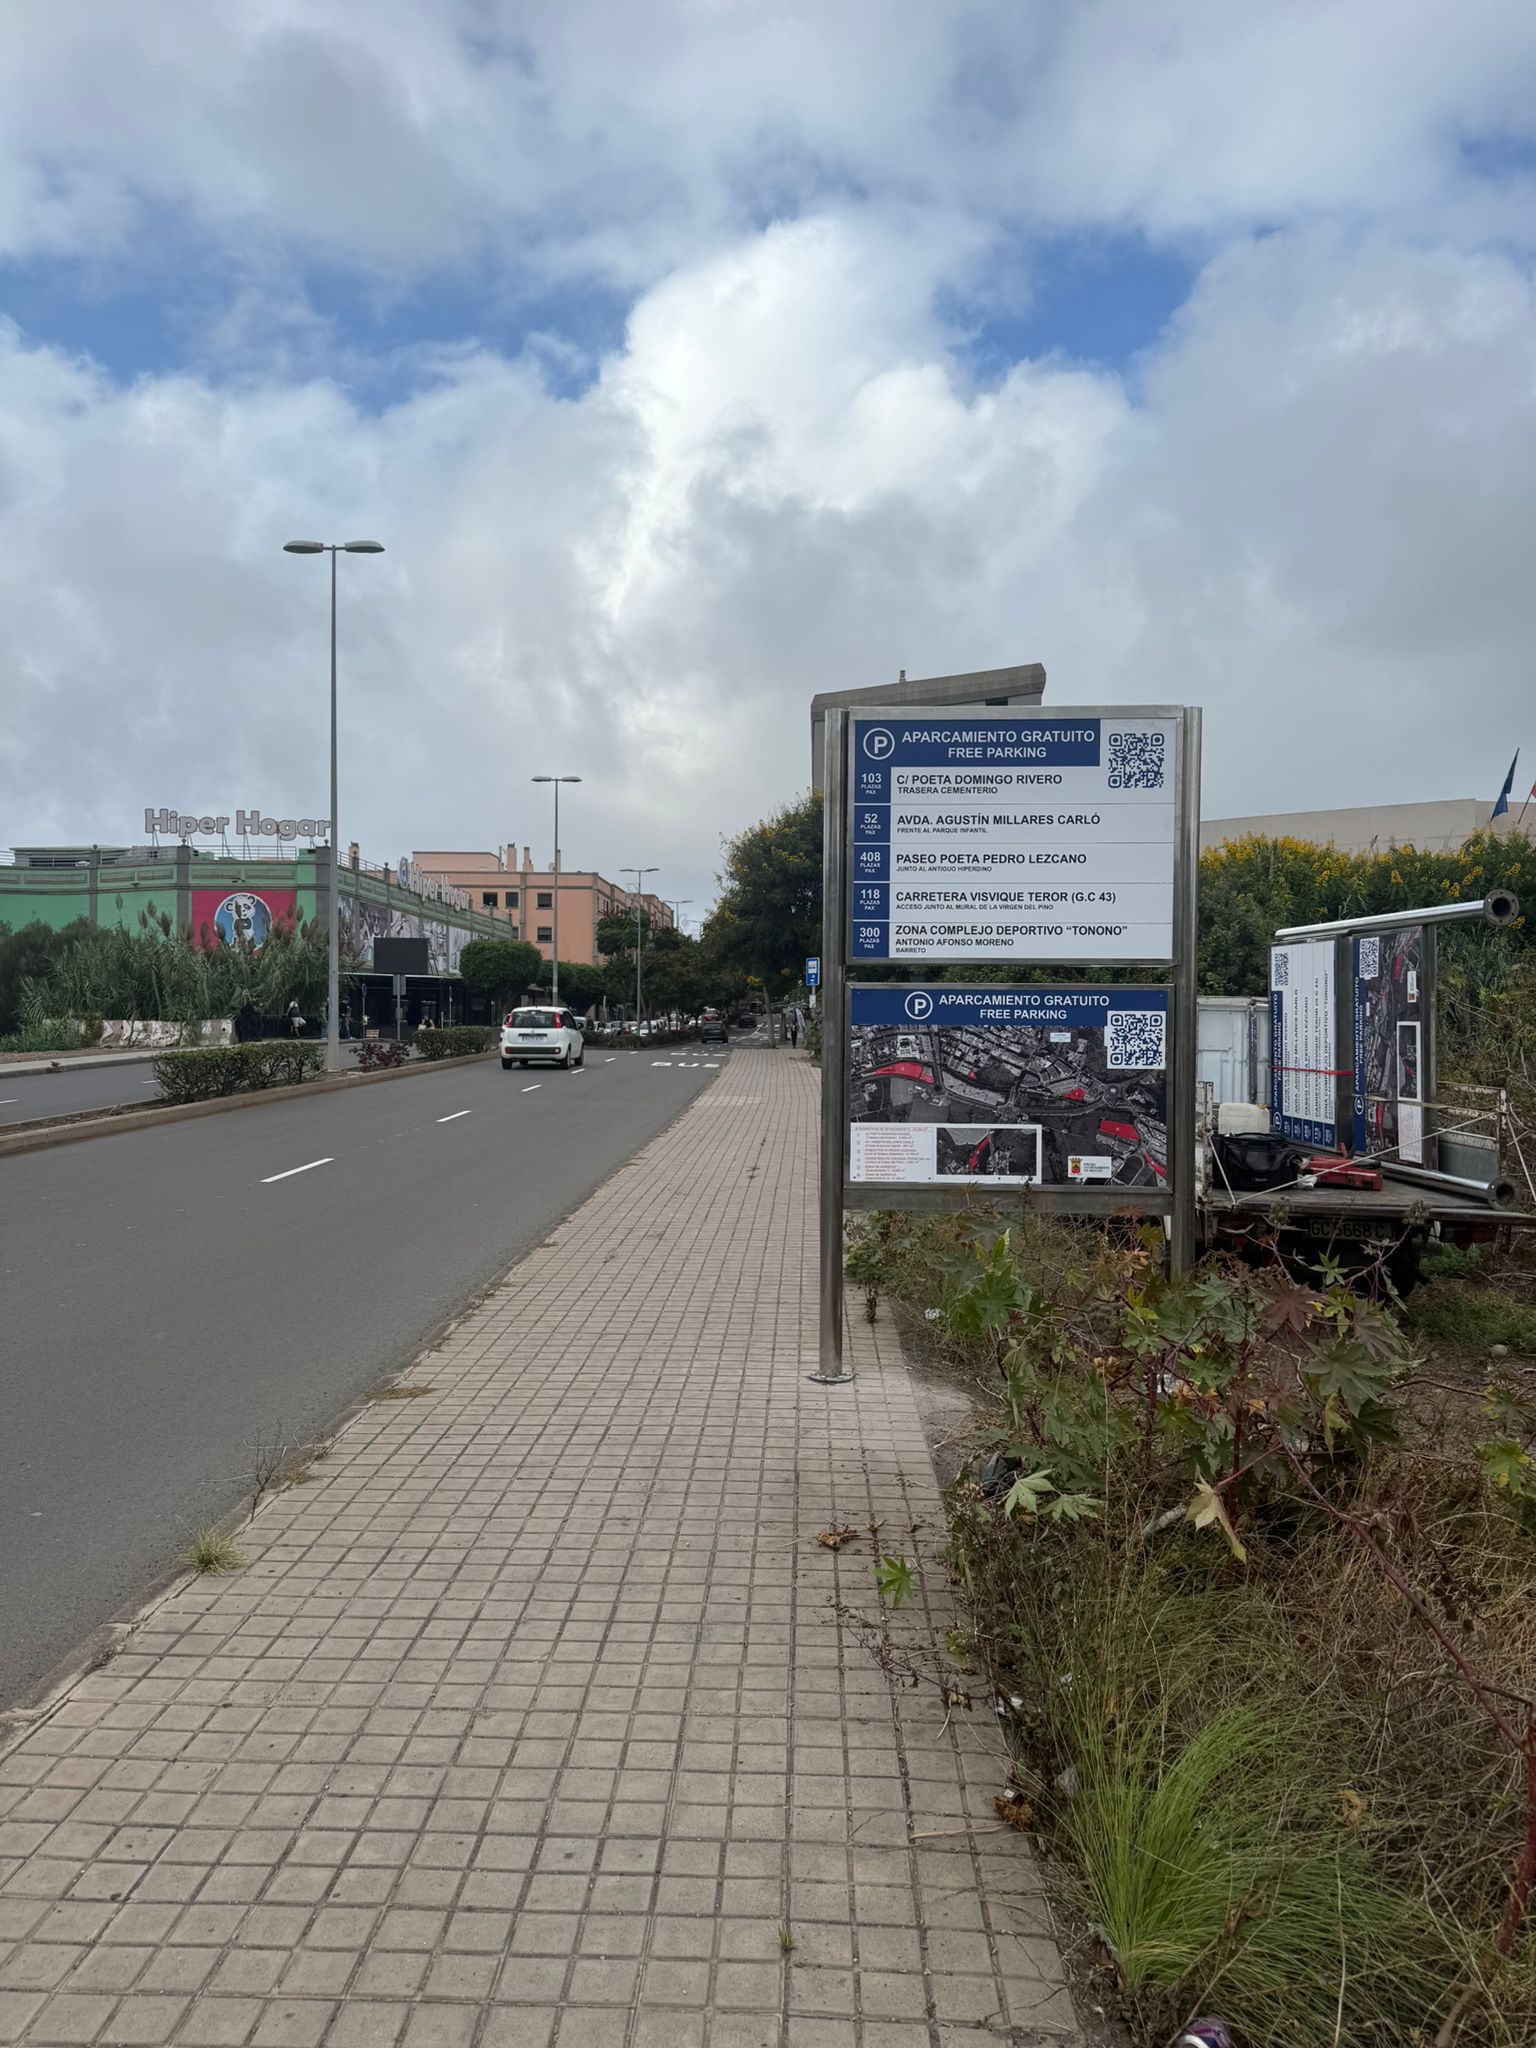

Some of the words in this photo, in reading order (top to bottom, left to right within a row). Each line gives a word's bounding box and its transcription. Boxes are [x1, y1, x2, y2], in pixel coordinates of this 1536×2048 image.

[902, 731, 1016, 743] APARCAMIENTO
[1021, 731, 1094, 742] GRATUITO
[948, 748, 982, 758] FREE
[987, 748, 1046, 758] PARKING
[861, 773, 881, 783] 103
[897, 775, 908, 784] C/
[912, 775, 951, 784] POETA
[955, 775, 1012, 784] DOMINGO
[1017, 775, 1062, 784] RIVERO
[864, 814, 877, 823] 52
[897, 816, 933, 825] AVDA.
[936, 813, 989, 825] AGUSTÍN
[993, 816, 1053, 825] MILLARES
[1058, 812, 1100, 824] CARLÓ
[145, 808, 229, 837] Hiper
[236, 810, 331, 841] Hogar
[860, 852, 880, 862] 408
[896, 854, 936, 864] PASEO
[940, 854, 980, 864] POETA
[983, 854, 1025, 864] PEDRO
[1029, 854, 1086, 864] LEZCANO
[860, 890, 880, 898] 118
[896, 892, 966, 902] CARRETERA
[970, 892, 1024, 902] VISVIQUE
[1028, 892, 1067, 901] TEROR
[1071, 892, 1095, 904] (G.C
[1099, 891, 1116, 903] 43)
[860, 928, 880, 938] 300
[896, 926, 927, 935] ZONA
[930, 926, 993, 935] COMPLEJO
[997, 926, 1062, 935] DEPORTIVO
[939, 996, 1040, 1006] APARCAMIENTO
[1044, 996, 1108, 1006] GRATUITO
[980, 1010, 1010, 1019] FREE
[1014, 1010, 1066, 1020] PARKING
